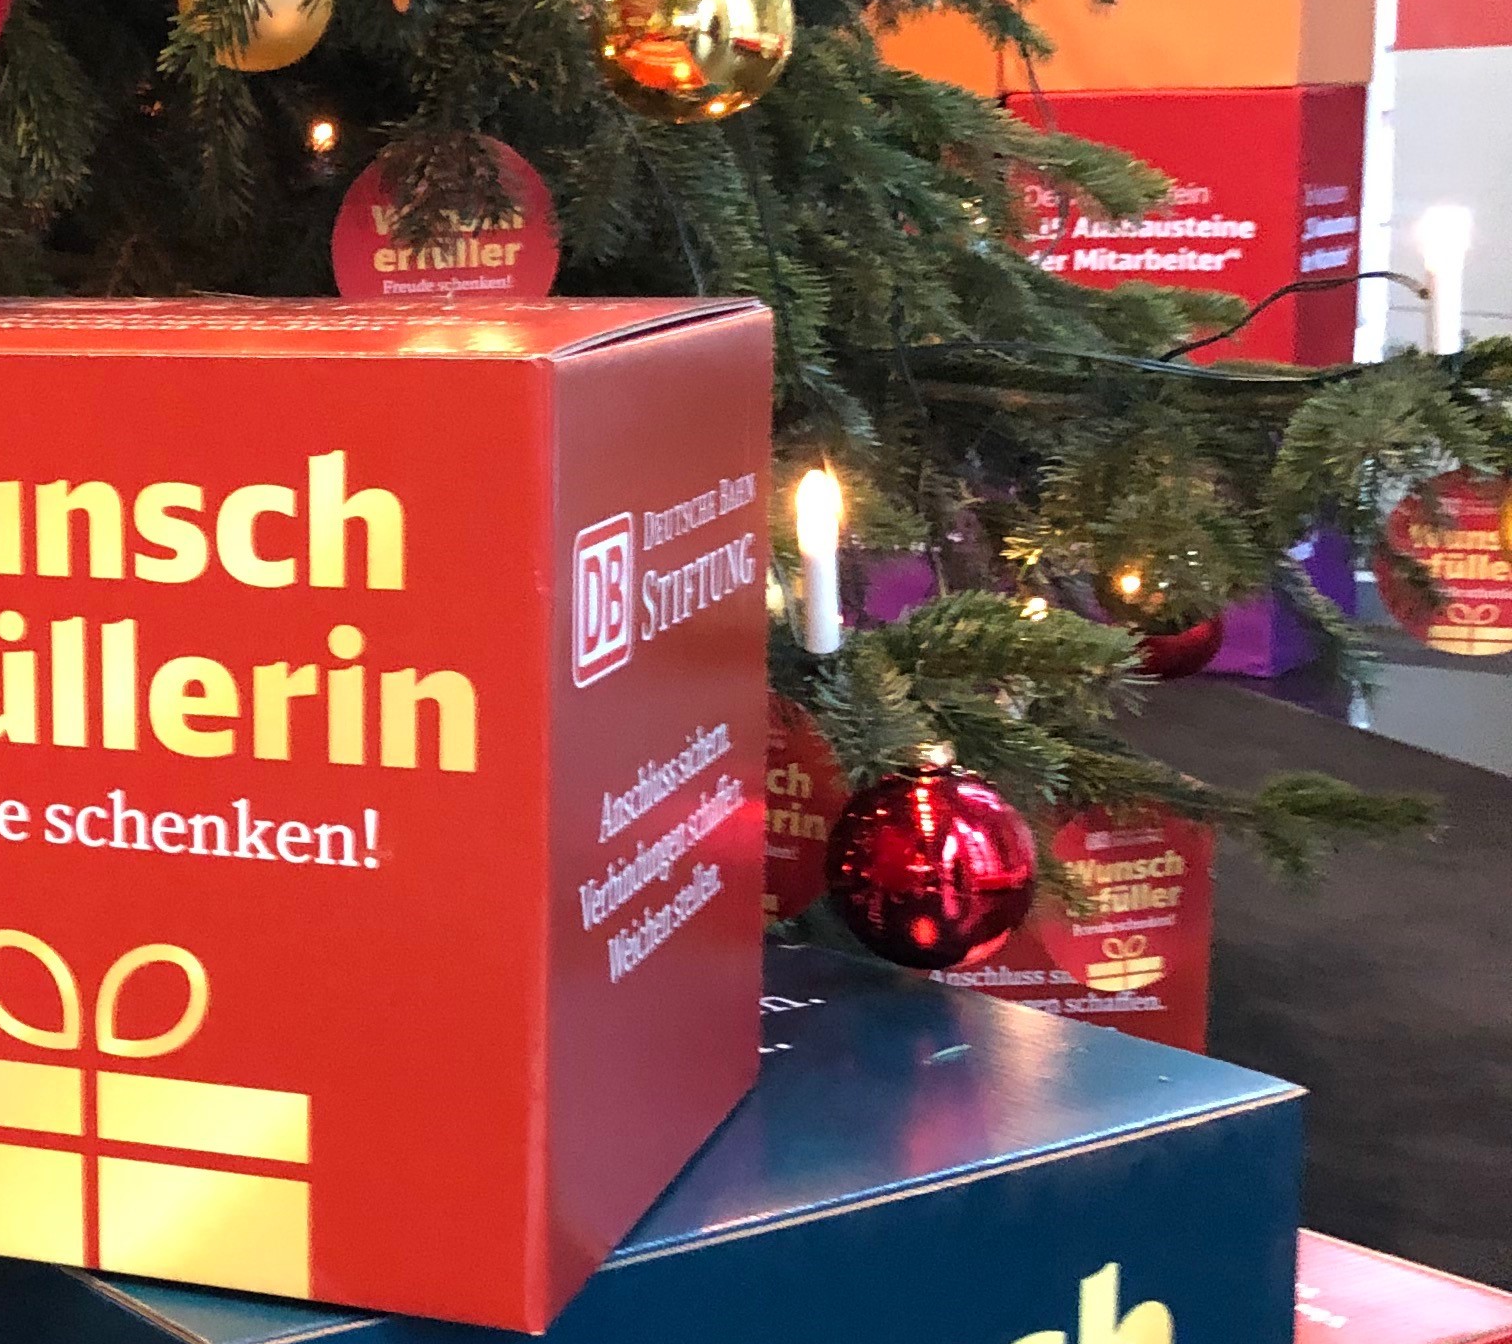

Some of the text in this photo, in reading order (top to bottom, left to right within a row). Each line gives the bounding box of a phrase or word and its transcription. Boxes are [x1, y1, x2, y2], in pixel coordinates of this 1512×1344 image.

[383, 275, 512, 294] Freude schenken!
[641, 531, 757, 641] STIFTUNG
[44, 788, 381, 869] schenken!
